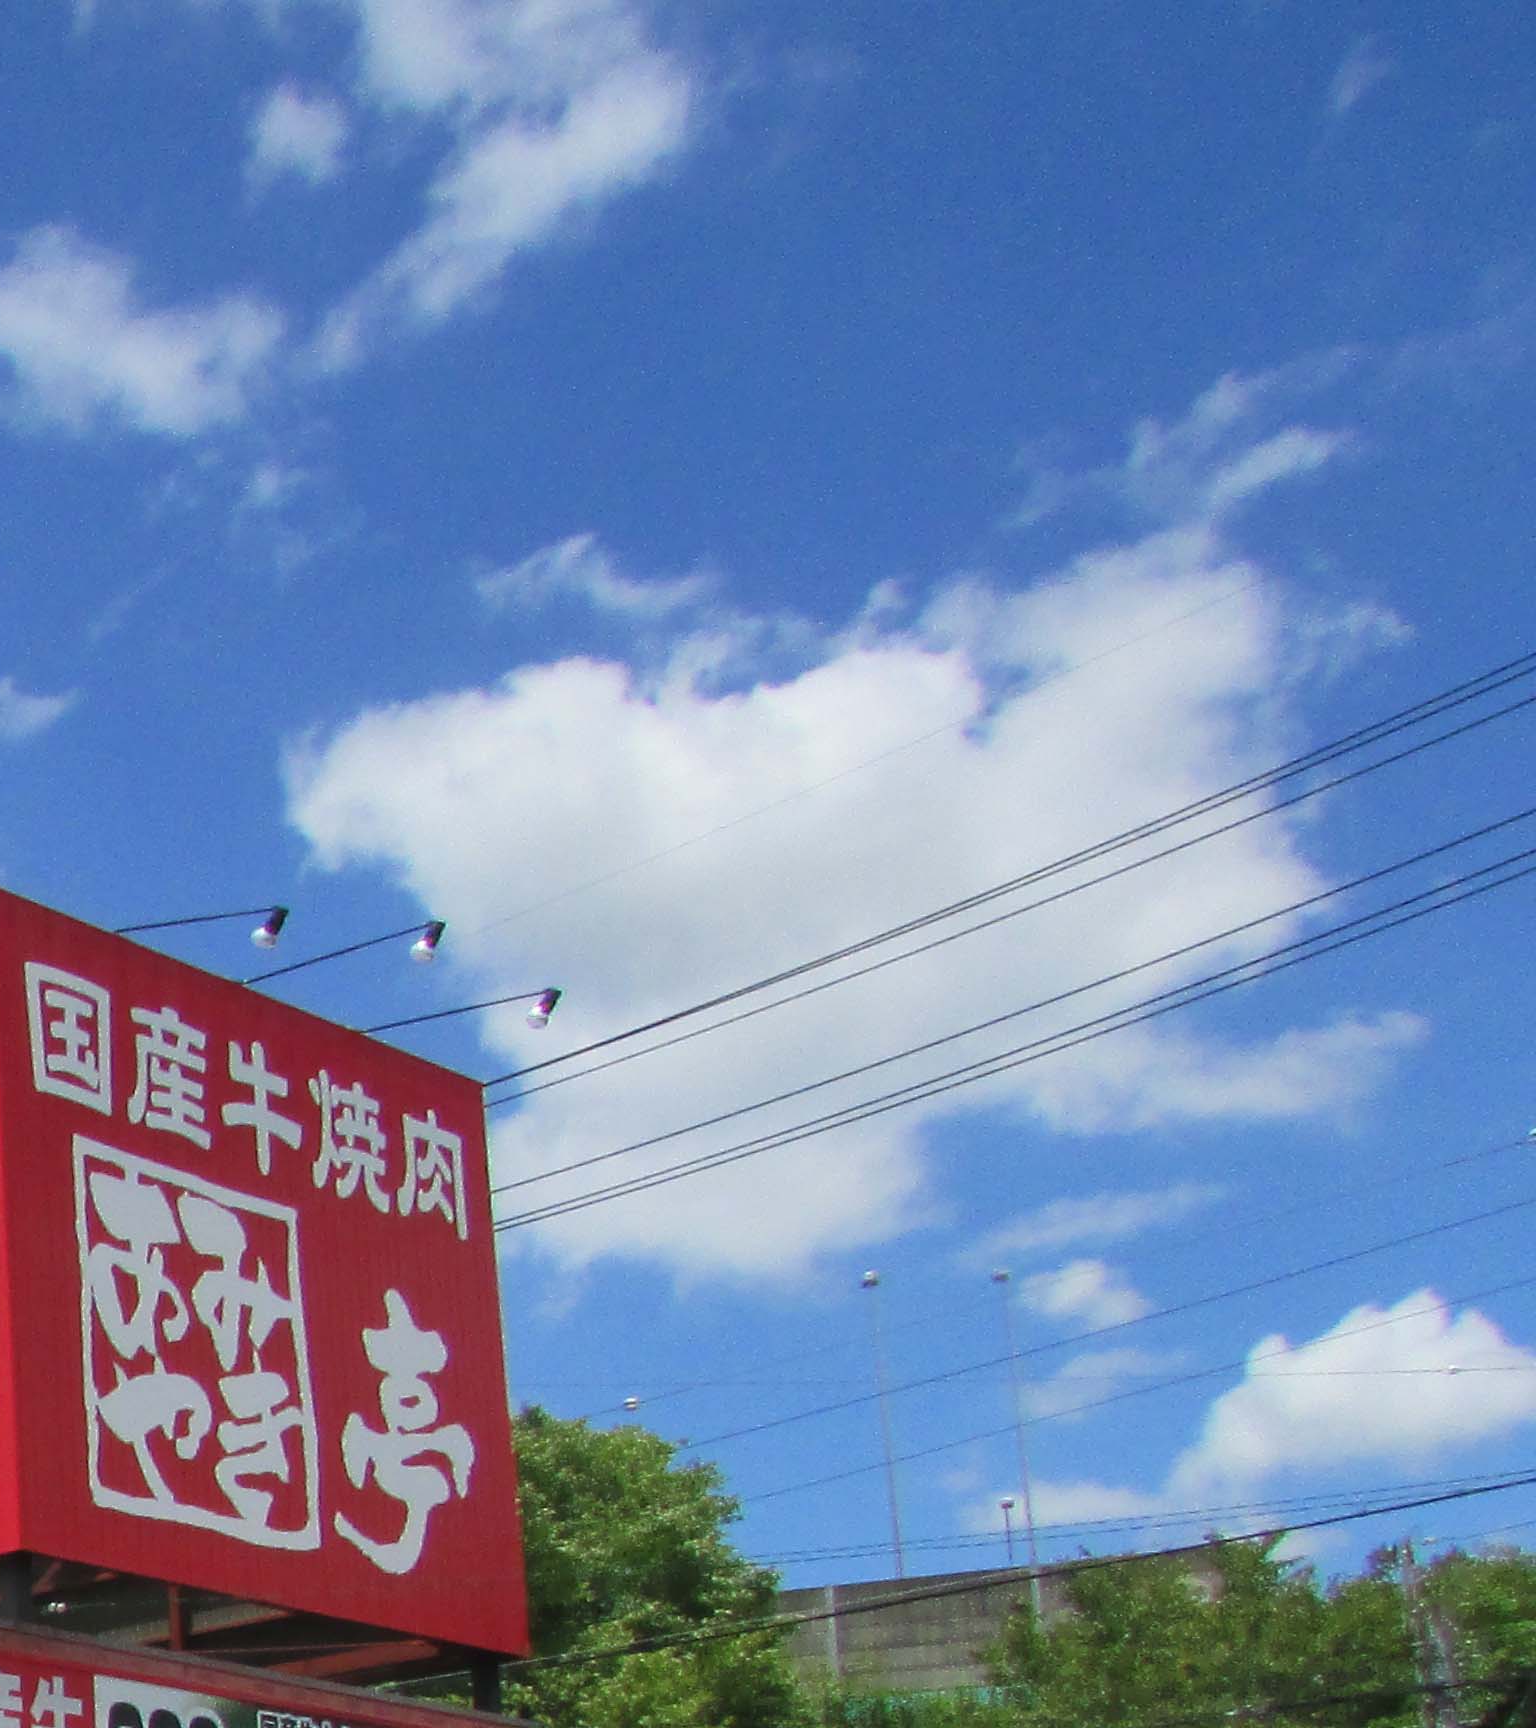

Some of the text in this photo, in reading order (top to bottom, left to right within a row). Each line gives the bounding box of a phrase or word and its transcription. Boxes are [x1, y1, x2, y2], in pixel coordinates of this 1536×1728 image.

[24, 960, 469, 1241] 国産牛焼肉
